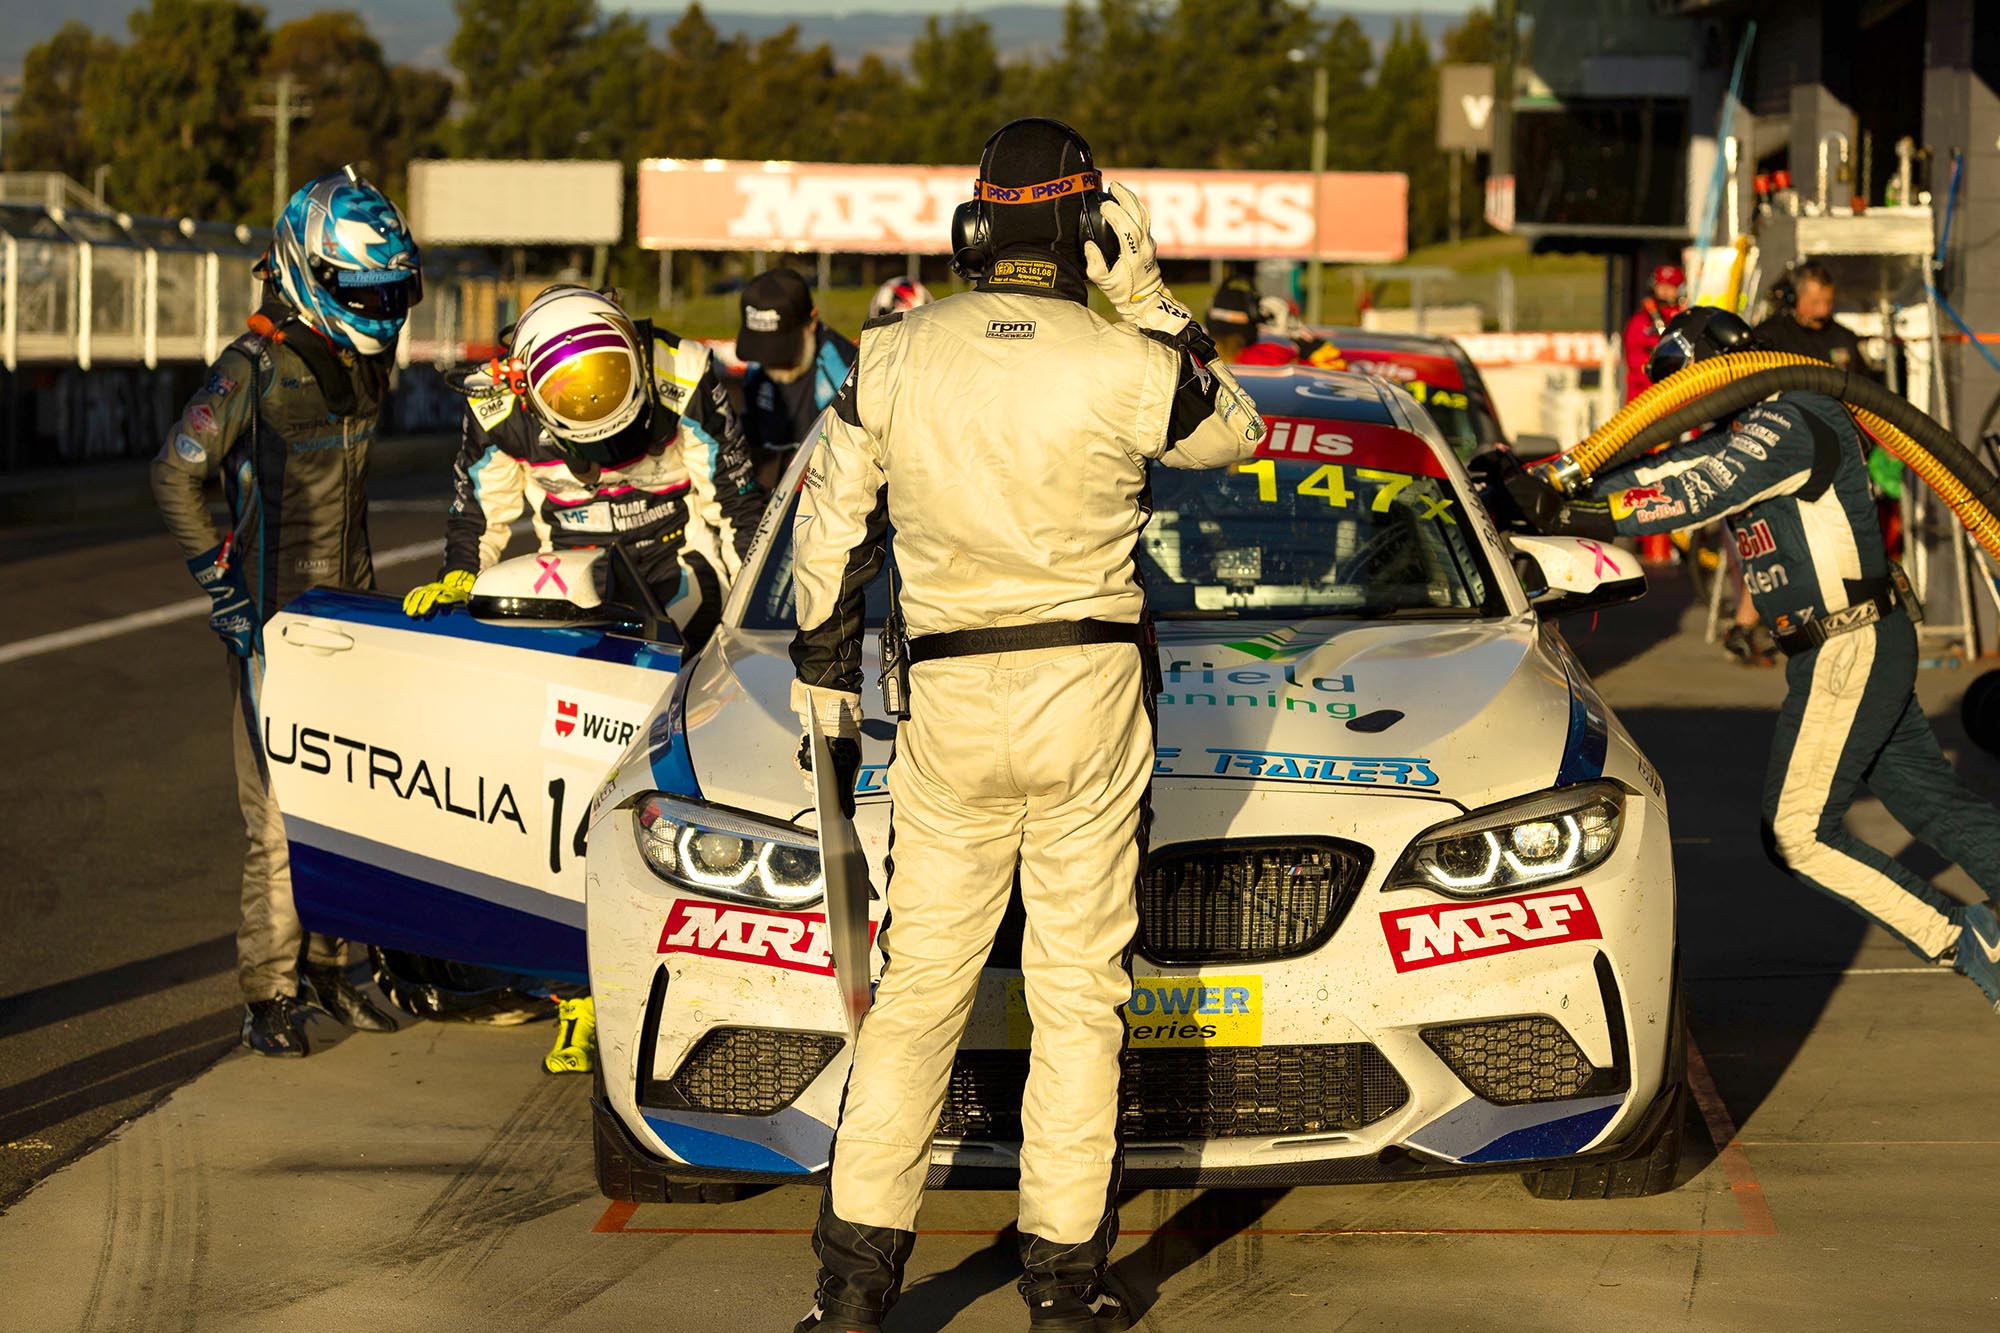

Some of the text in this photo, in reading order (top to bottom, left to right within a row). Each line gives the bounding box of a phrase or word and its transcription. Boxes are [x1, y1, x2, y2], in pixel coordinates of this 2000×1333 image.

[992, 323, 1033, 333] rpm
[479, 401, 504, 417] OMP
[659, 384, 686, 399] OMP
[1257, 421, 1354, 456] ils
[1238, 459, 1413, 513] 147
[611, 500, 648, 518] TRADE
[614, 501, 676, 532] WAREHOUSE
[1737, 521, 1775, 558] Bull
[583, 712, 642, 747] WÜR
[265, 716, 528, 835] USTRALIA
[1396, 893, 1584, 963] MRF
